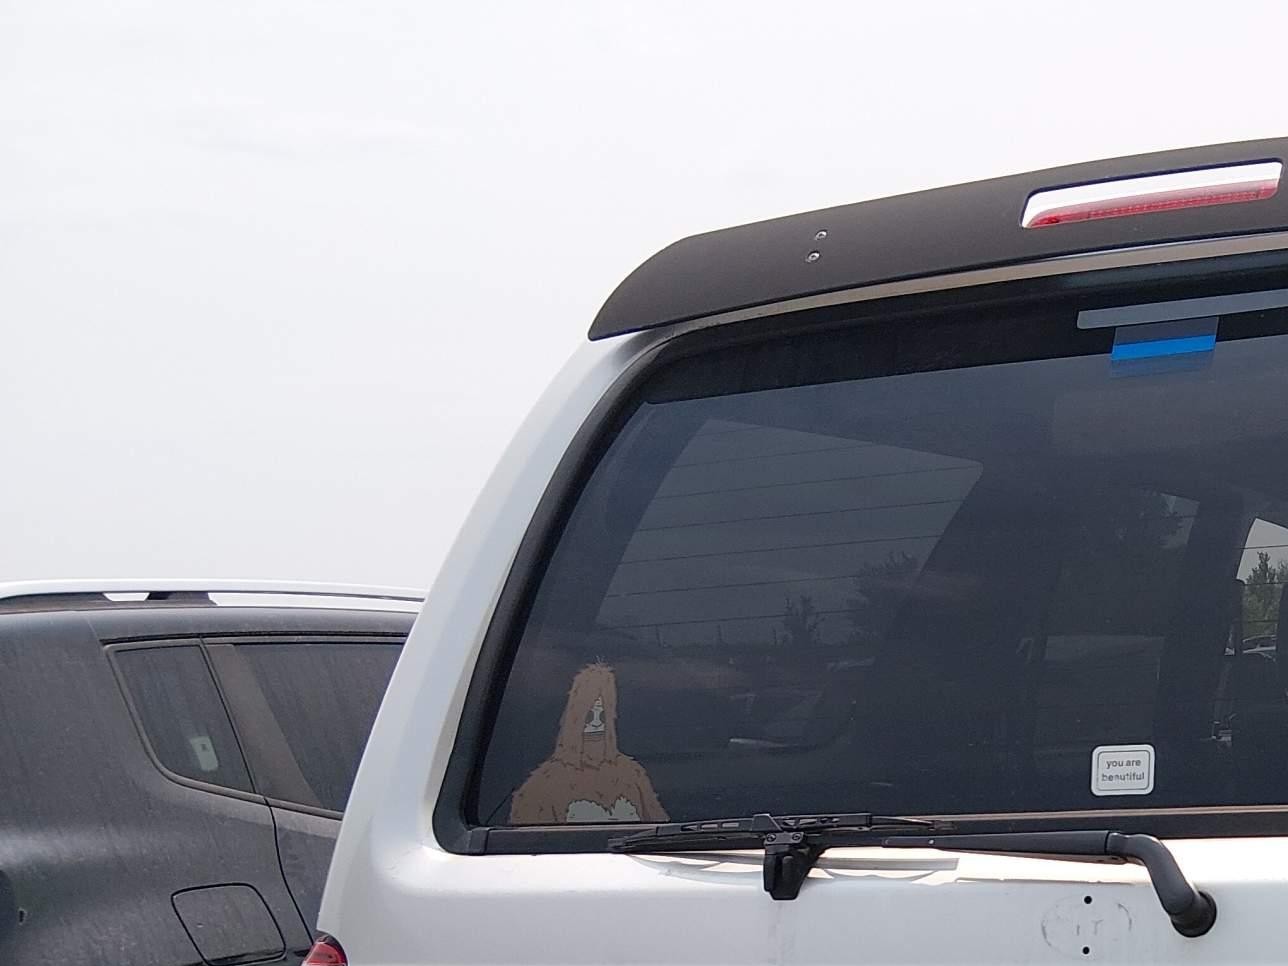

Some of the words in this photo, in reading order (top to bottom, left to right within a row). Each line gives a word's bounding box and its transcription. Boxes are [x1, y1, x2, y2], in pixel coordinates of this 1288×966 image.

[1106, 760, 1123, 769] you
[1126, 759, 1141, 767] are
[1101, 772, 1145, 781] beautiful
